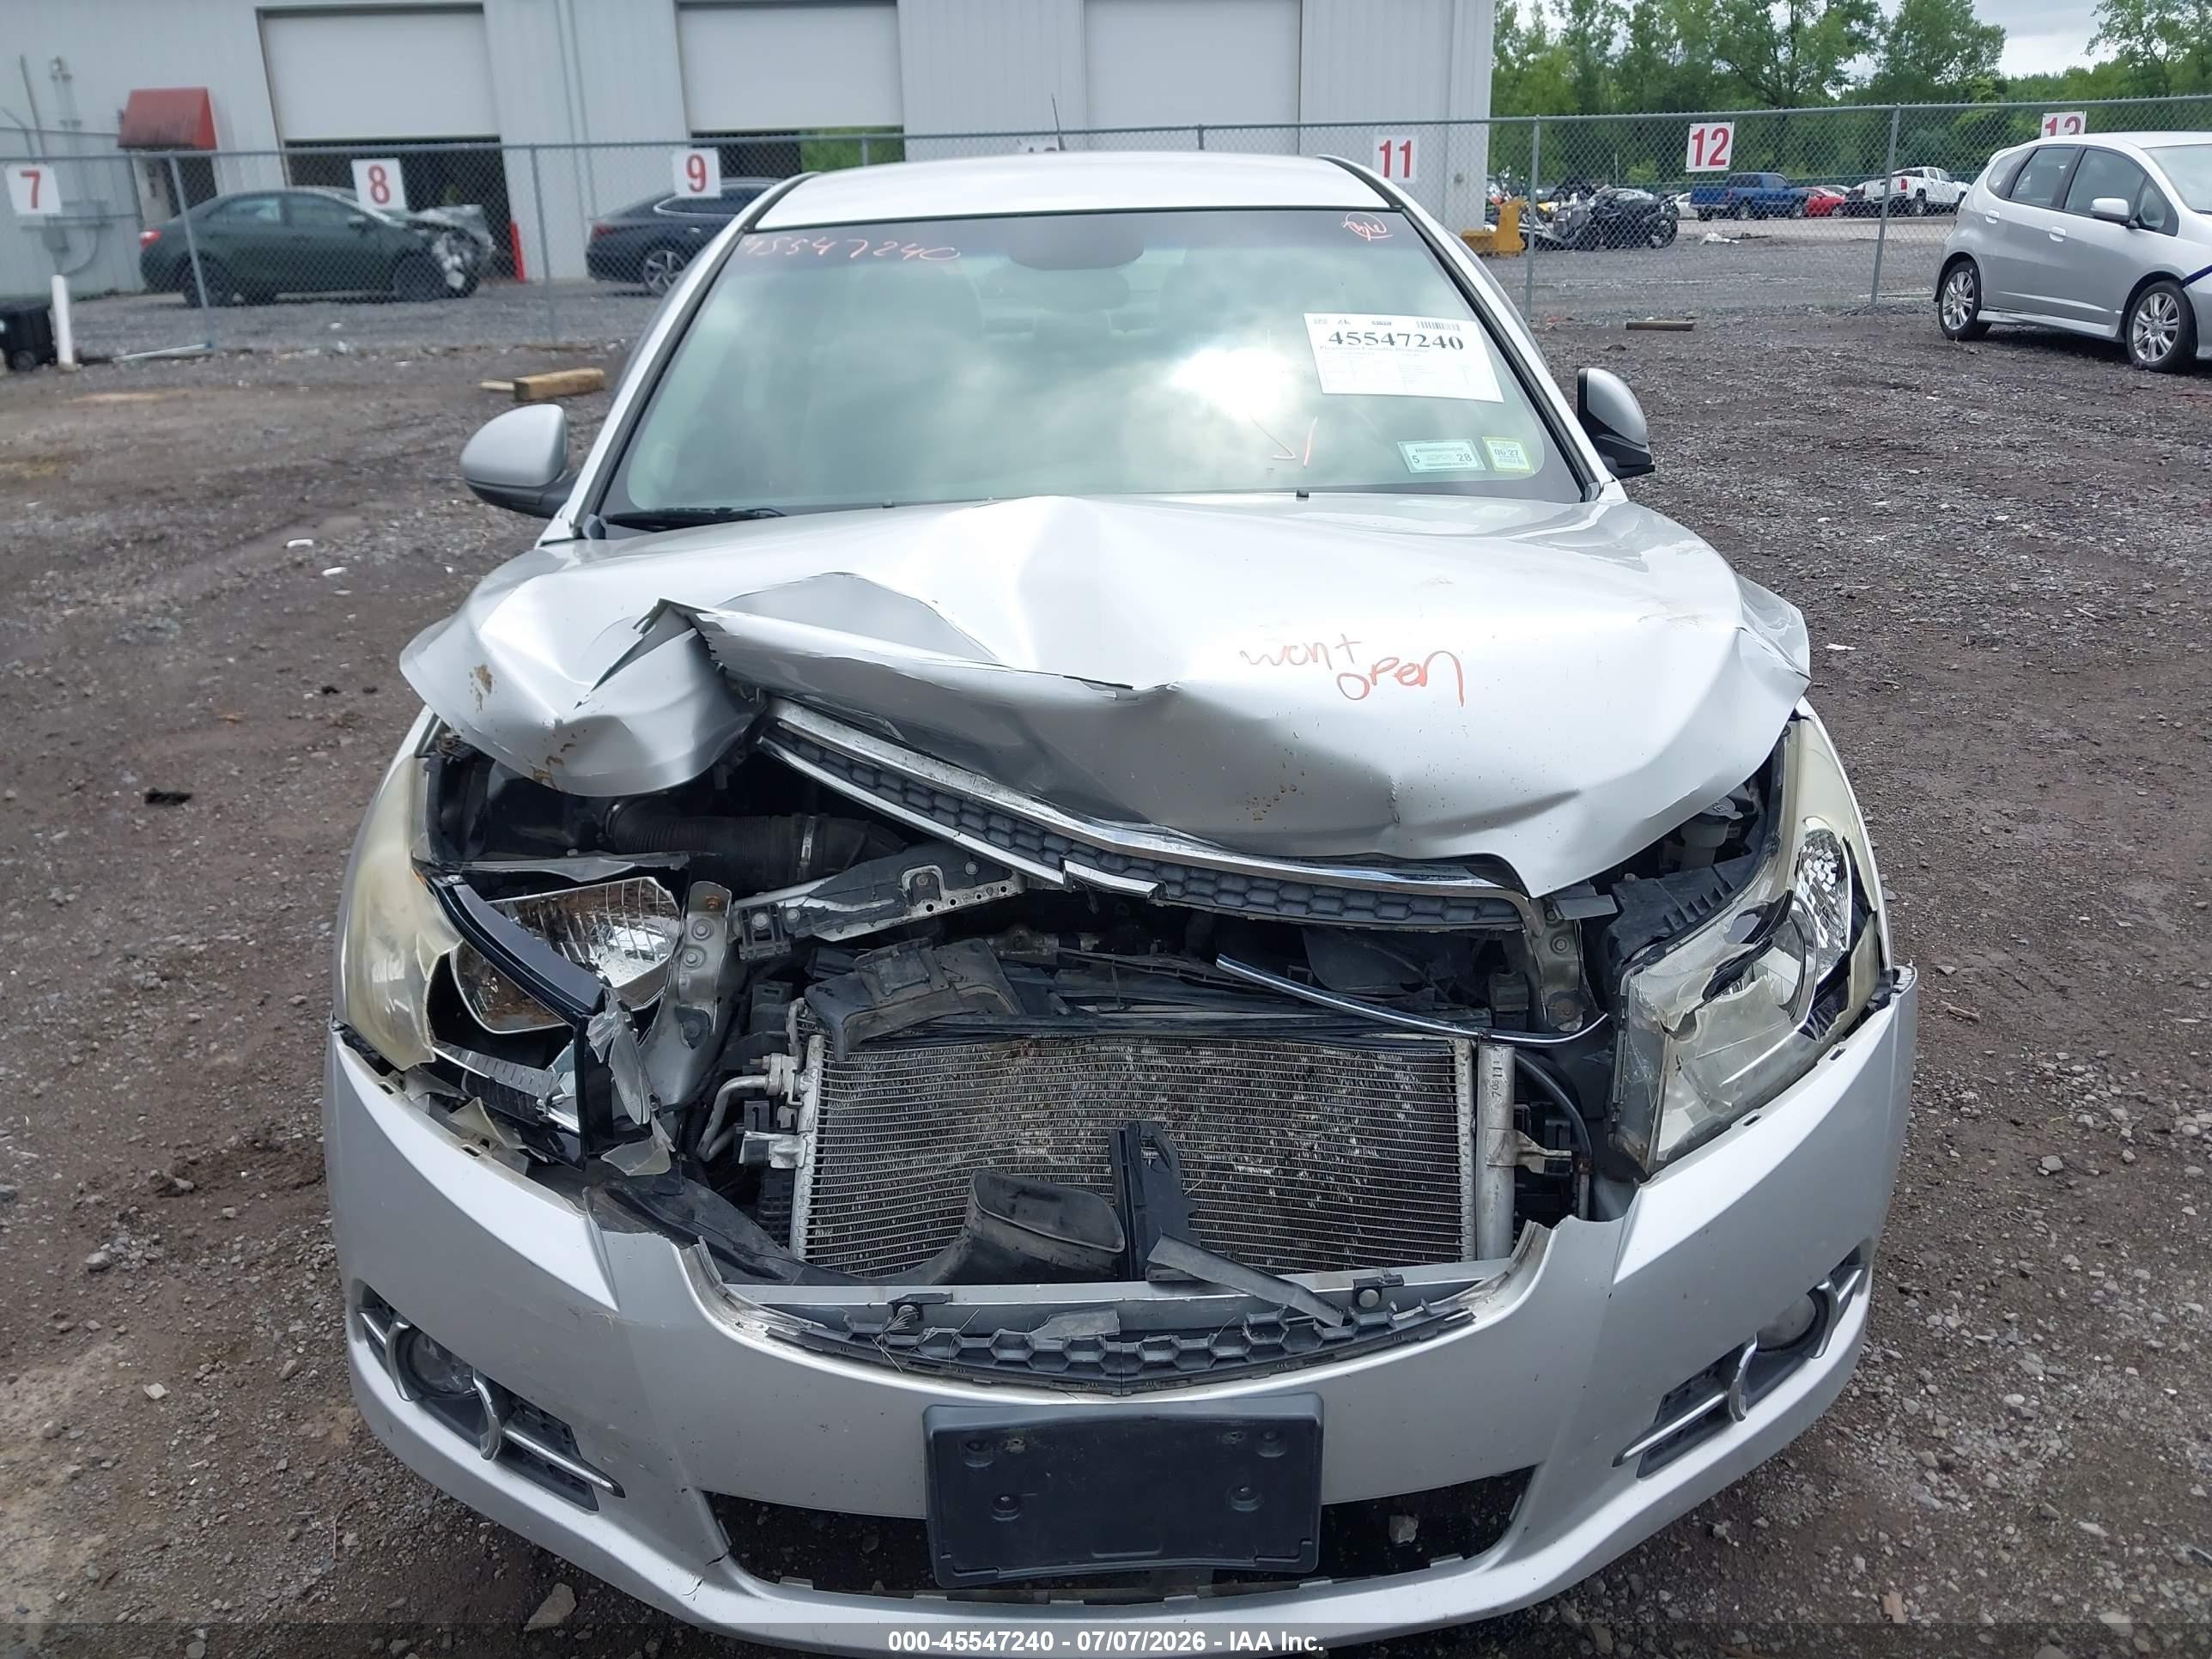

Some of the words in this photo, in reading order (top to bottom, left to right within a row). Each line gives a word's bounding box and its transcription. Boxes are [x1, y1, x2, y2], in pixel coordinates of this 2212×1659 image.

[1380, 141, 1413, 179] 11
[1692, 128, 1729, 167] 12
[20, 170, 40, 209] 7
[369, 164, 391, 204] 8
[686, 155, 708, 193] 9
[1328, 331, 1464, 350] 45547240
[1412, 455, 1420, 464] 5
[1456, 453, 1472, 462] 28
